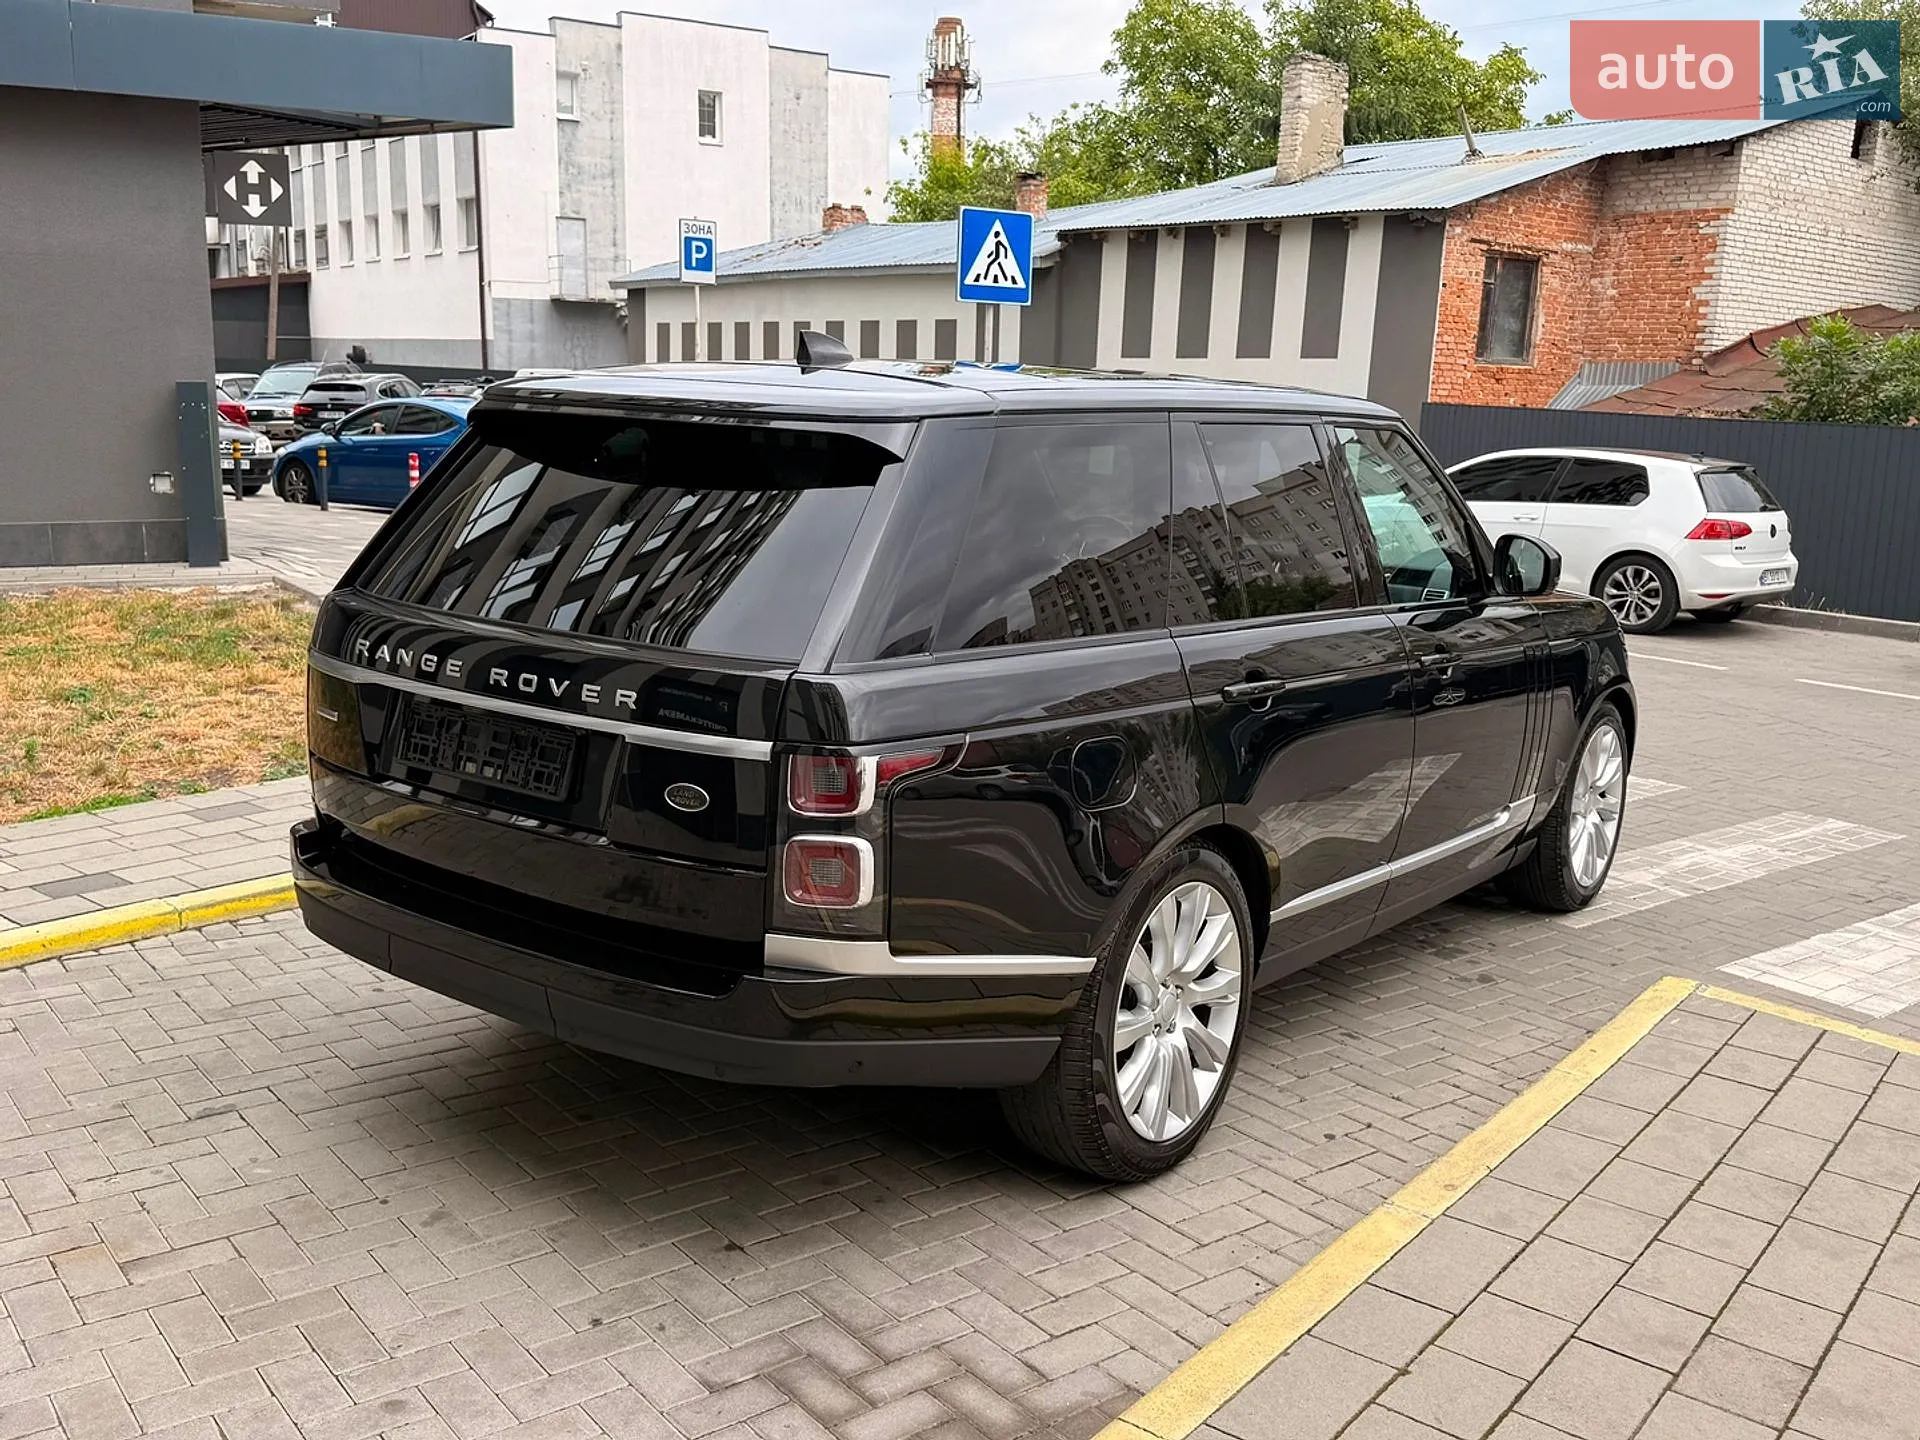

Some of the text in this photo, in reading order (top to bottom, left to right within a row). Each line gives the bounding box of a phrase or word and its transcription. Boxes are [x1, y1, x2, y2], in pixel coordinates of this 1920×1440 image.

[683, 222, 713, 236] ЗОНА
[691, 240, 708, 267] P
[354, 637, 638, 710] RANGE ROVER
